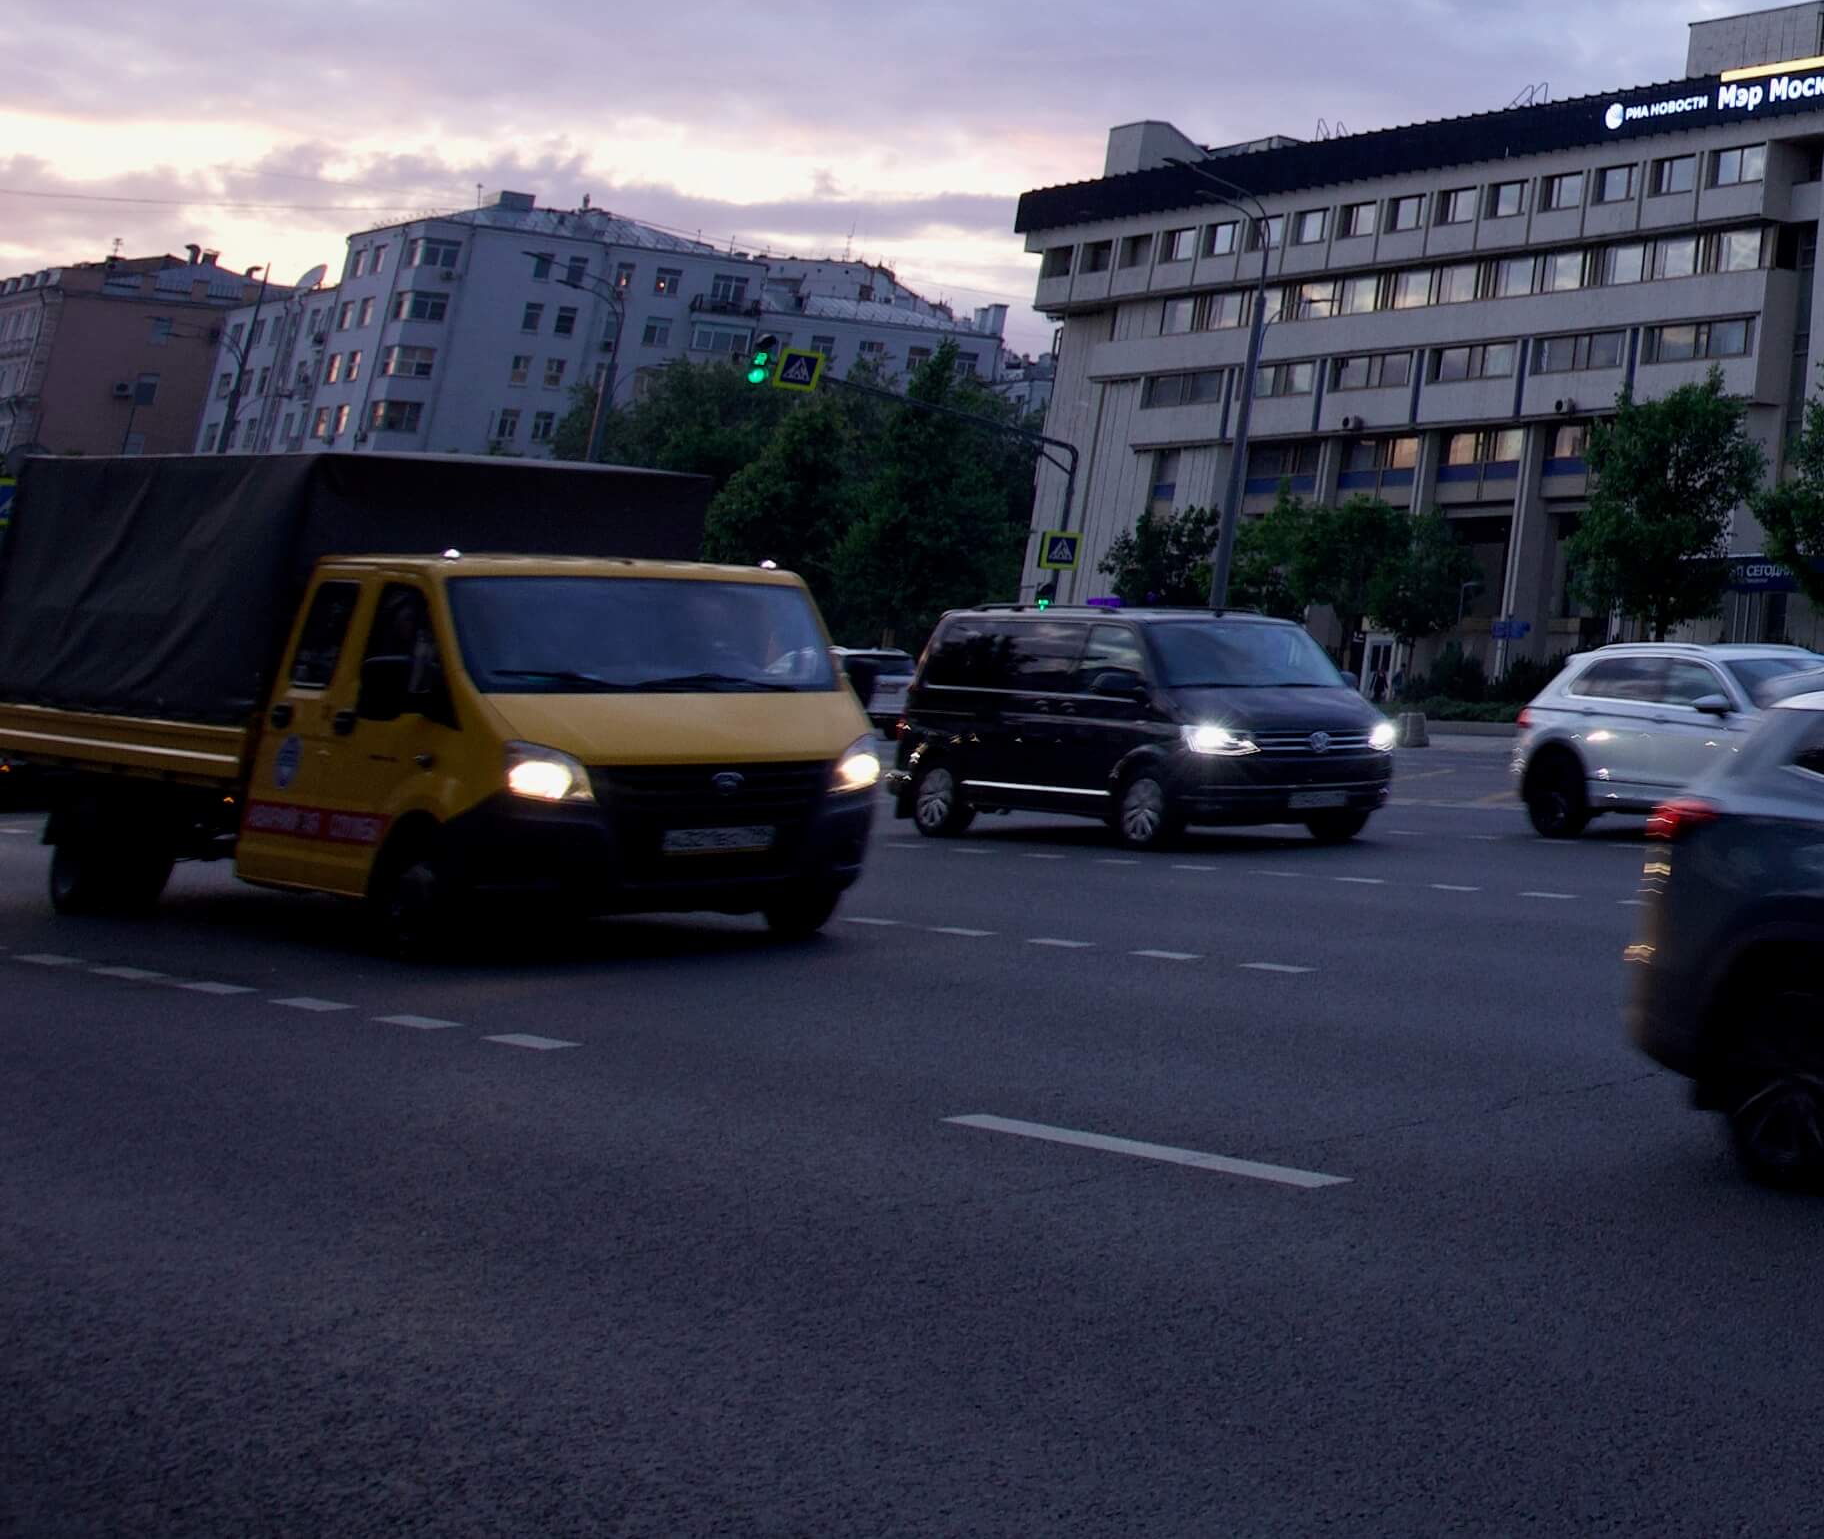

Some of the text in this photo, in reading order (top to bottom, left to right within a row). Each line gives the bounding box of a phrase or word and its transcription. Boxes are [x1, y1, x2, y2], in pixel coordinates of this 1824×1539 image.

[1625, 95, 1708, 122] РИА НОВОСТИ
[1717, 84, 1763, 112] Мэр
